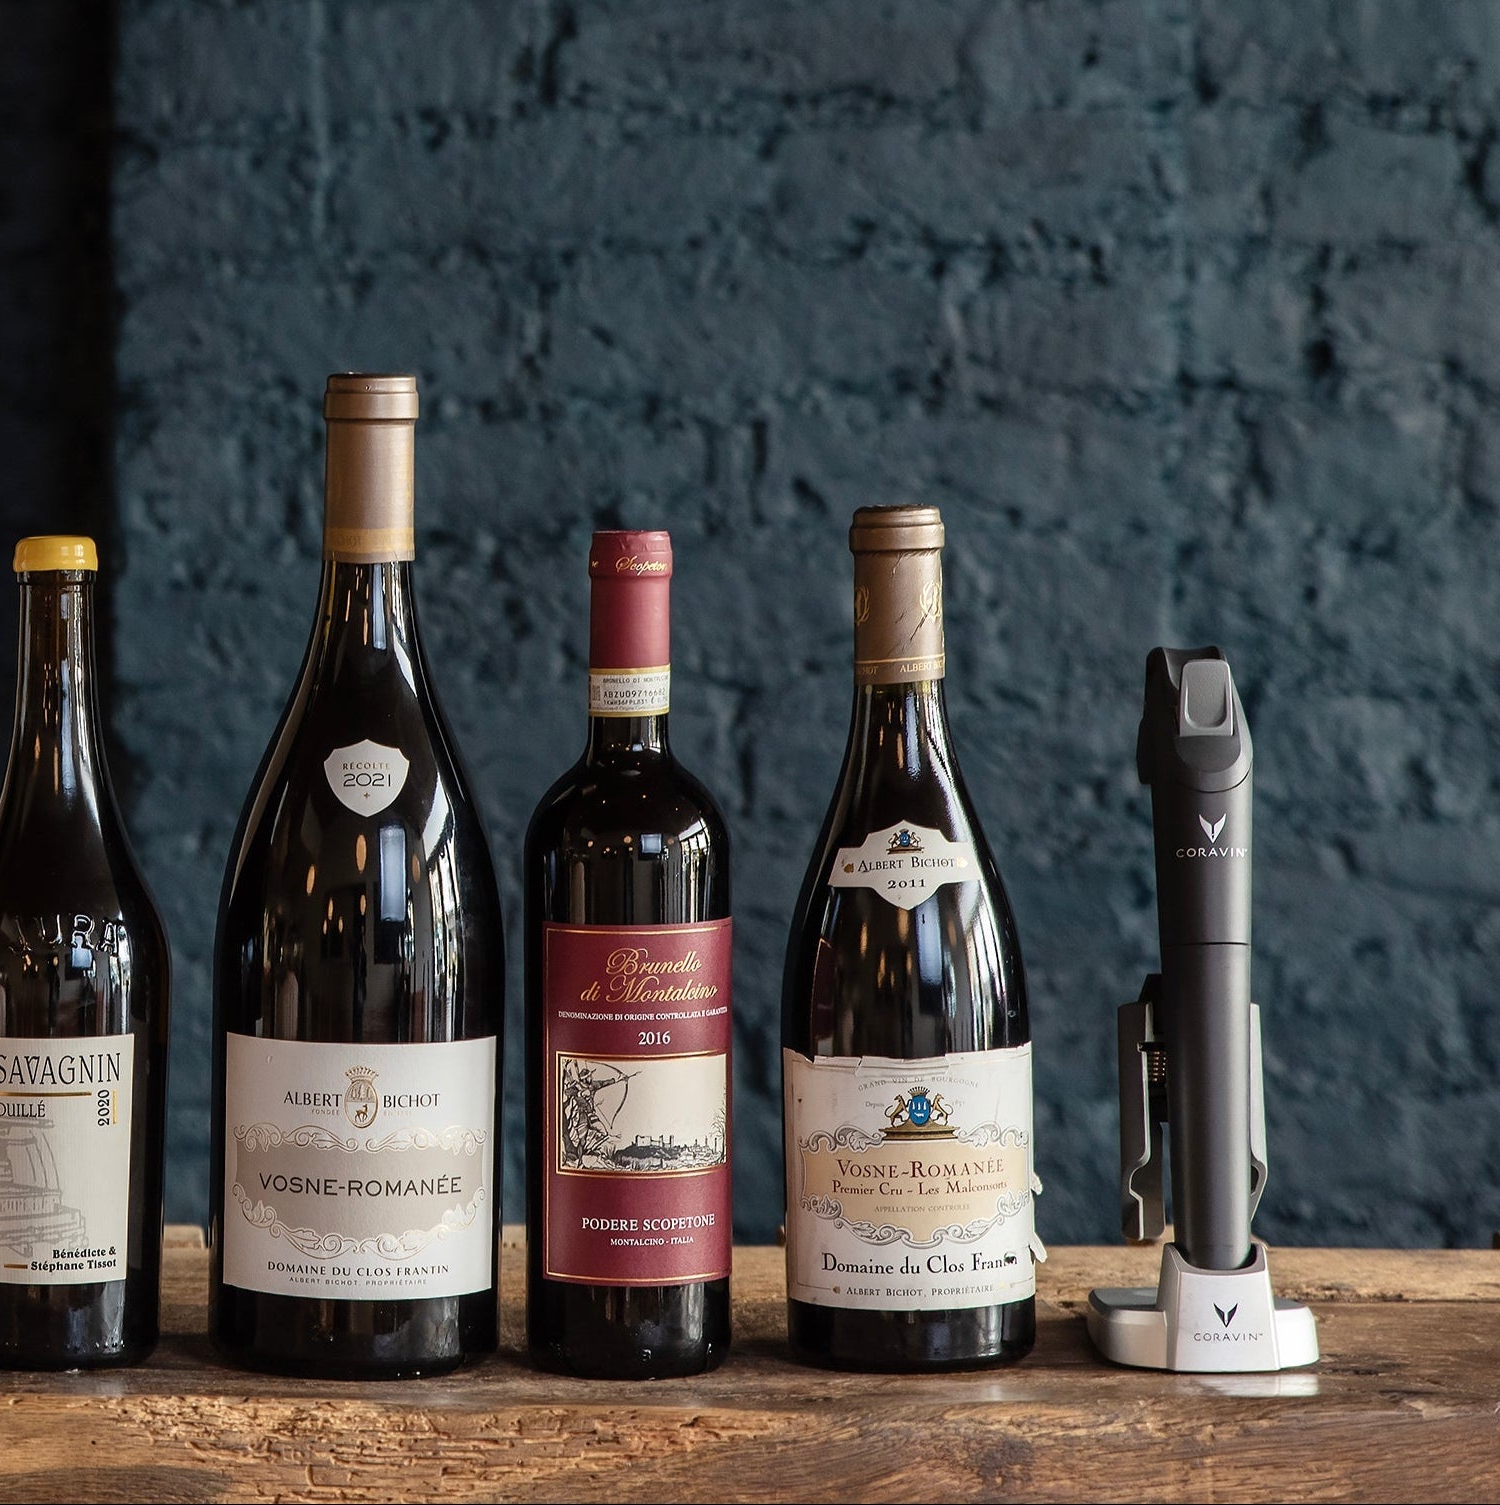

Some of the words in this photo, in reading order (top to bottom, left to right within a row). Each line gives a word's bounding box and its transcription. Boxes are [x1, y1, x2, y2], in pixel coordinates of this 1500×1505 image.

[900, 661, 932, 672] ALBERT
[343, 773, 390, 787] 2021
[858, 860, 904, 872] ALBERT
[911, 856, 954, 868] BICHOT
[888, 879, 925, 889] 2011
[606, 948, 701, 975] Brunello
[580, 982, 601, 1001] di
[606, 975, 718, 1003] Montalcino
[558, 1010, 614, 1020] DENOMINAZIONE
[656, 1010, 701, 1020] CONTROLLATA
[638, 1031, 670, 1045] 2016
[858, 1079, 886, 1091] GRAND
[932, 1076, 978, 1088] BOURGOGNE
[284, 1091, 342, 1107] ALBERT
[383, 1094, 440, 1108] BICHOT
[98, 1089, 110, 1126] 2020
[836, 1157, 1004, 1179] VOSNE-ROMANÉE
[259, 1172, 462, 1197] VOSNE-ROMANÉE
[832, 1180, 874, 1195] Premier
[879, 1182, 902, 1196] Cru
[918, 1182, 940, 1195] Les
[946, 1180, 1007, 1194] Malconsorts
[582, 1218, 638, 1231] PODERE
[643, 1214, 715, 1230] SCOPETONE
[610, 1238, 664, 1246] MONTALCINO
[671, 1236, 694, 1244] ITALIA
[52, 1247, 107, 1258] Bénédicte
[108, 1246, 116, 1256] &
[30, 1259, 84, 1272] Stéphane
[87, 1258, 116, 1270] Tissot
[268, 1261, 326, 1275] DOMAINE
[332, 1267, 350, 1276] DU
[357, 1267, 391, 1276] CLOS
[397, 1265, 449, 1276] FRANTIN
[822, 1252, 894, 1274] Domaine
[900, 1256, 920, 1274] du
[927, 1255, 964, 1274] Clos
[971, 1252, 1018, 1271] Frann
[846, 1287, 880, 1296] ALBERT
[932, 1284, 994, 1296] PROPRIÉTAIRE
